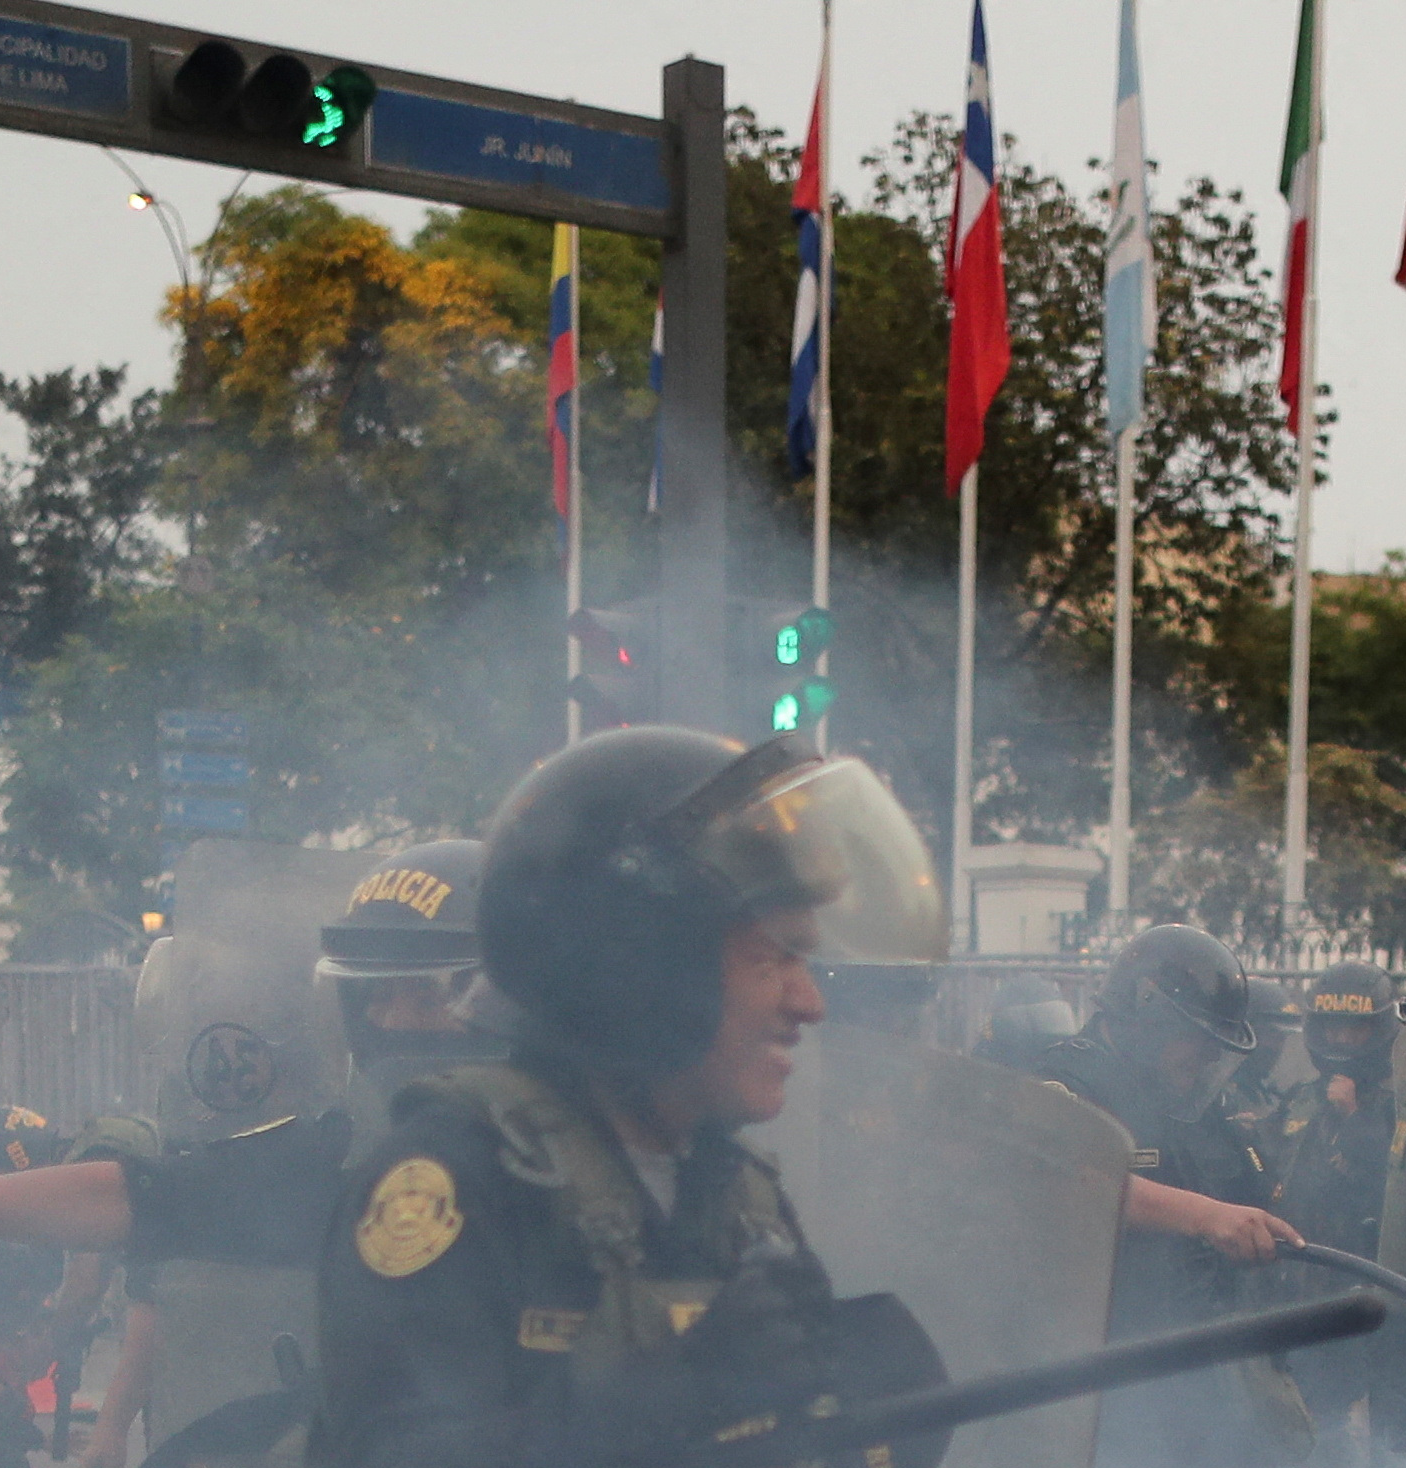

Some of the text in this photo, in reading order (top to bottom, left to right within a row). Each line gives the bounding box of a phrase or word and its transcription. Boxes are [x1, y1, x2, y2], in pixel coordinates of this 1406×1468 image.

[18, 68, 70, 94] LIMA
[345, 868, 453, 920] POLICIA
[1314, 993, 1373, 1013] POLICIA
